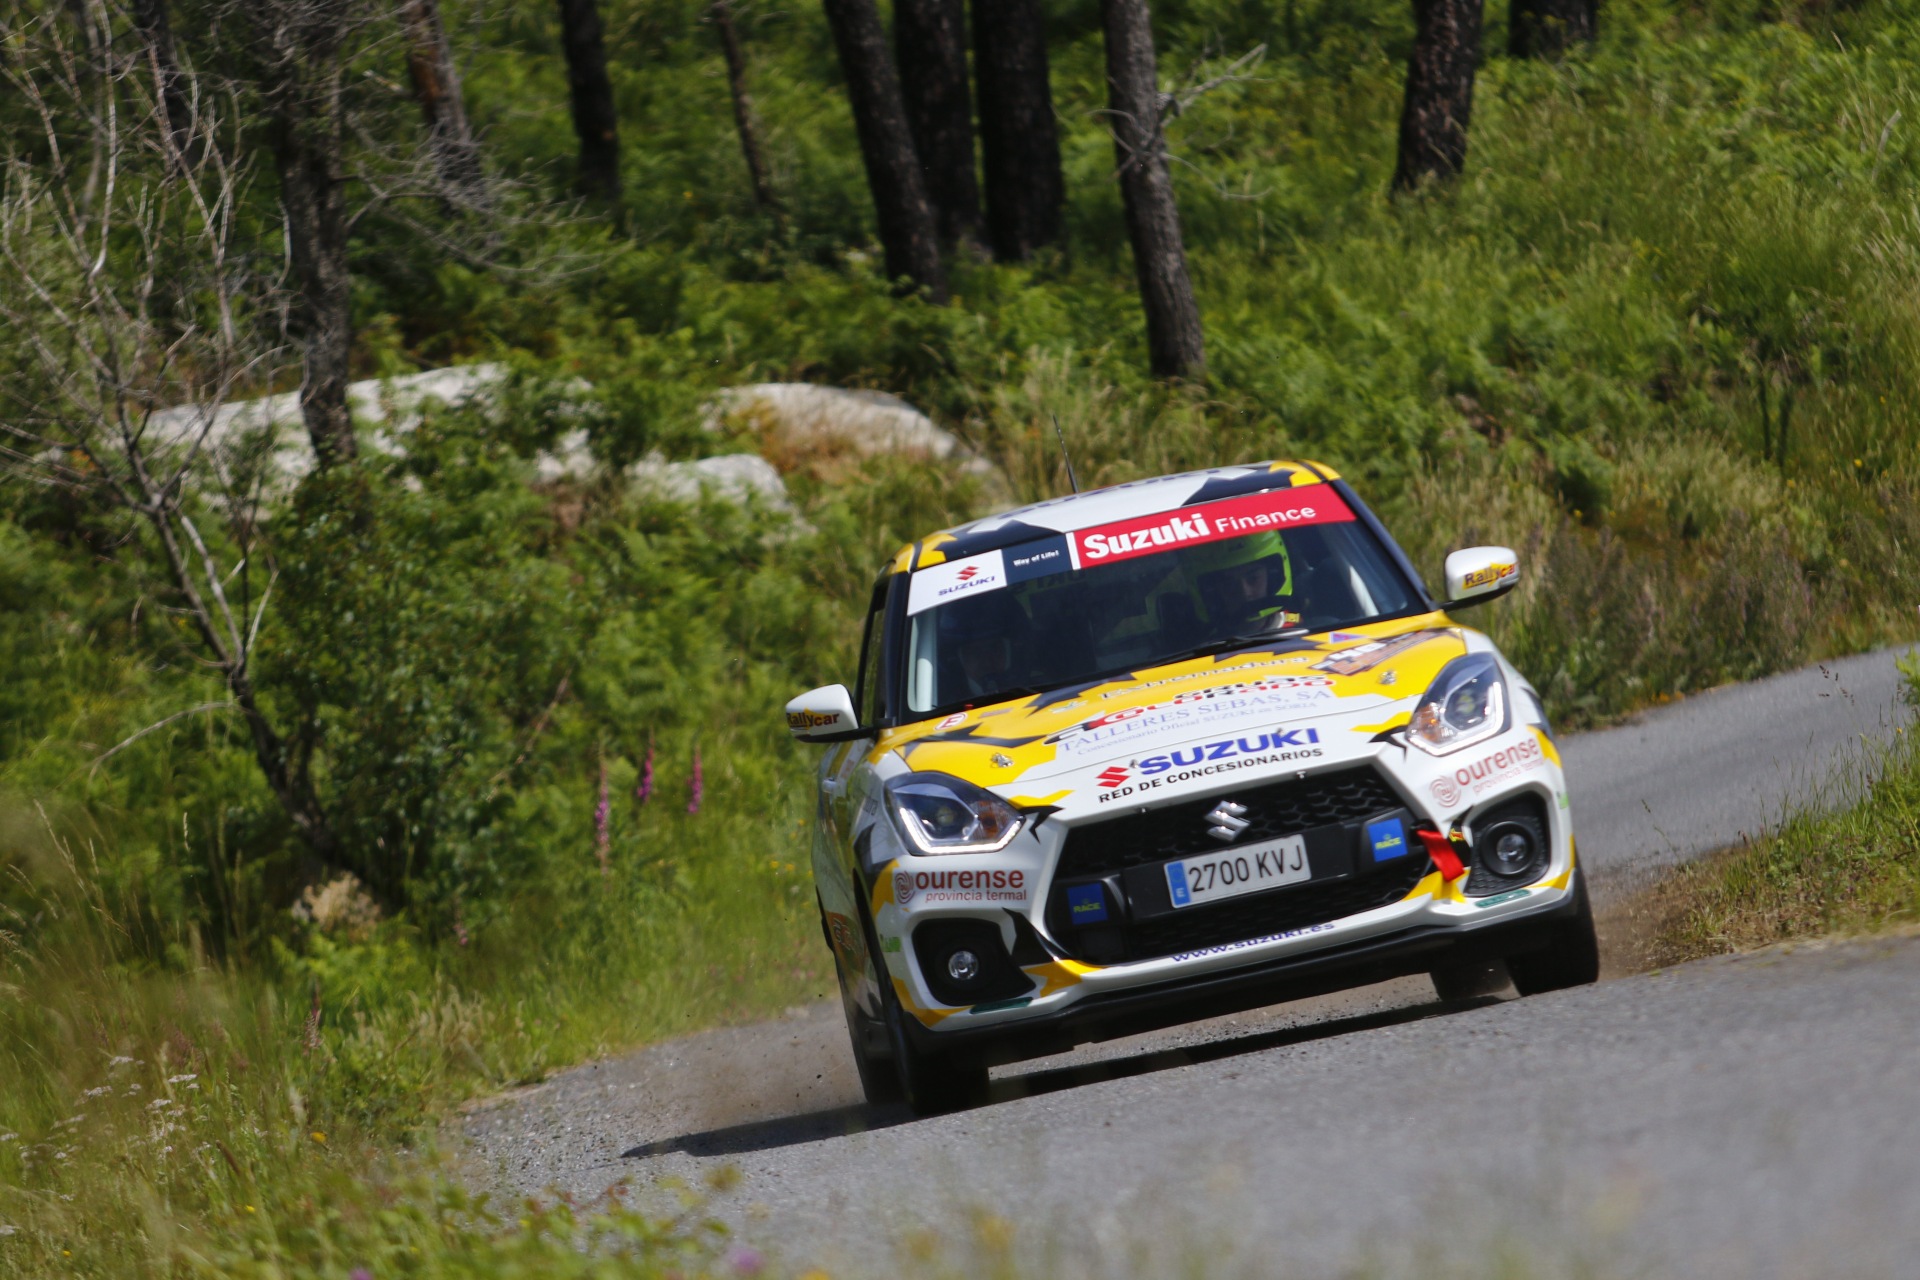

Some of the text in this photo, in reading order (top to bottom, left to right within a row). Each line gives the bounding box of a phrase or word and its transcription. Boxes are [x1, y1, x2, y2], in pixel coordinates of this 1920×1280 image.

[1083, 507, 1316, 559] Suzuki Finance
[1013, 549, 1060, 567] Way of Life!
[938, 576, 995, 597] SUZUKI
[1101, 656, 1309, 699] Extremadura
[1060, 708, 1190, 751] TALLERES
[1296, 690, 1331, 700] SA
[1203, 708, 1255, 723] SUZUKI
[1139, 727, 1320, 775] SUZUKI
[1455, 738, 1538, 786] ourense
[1098, 748, 1323, 804] RED DE CONCESIONARIOS
[915, 870, 1025, 890] ourense
[1176, 845, 1304, 898] E 2700 KVJ
[925, 889, 1027, 903] provincia termal
[1073, 902, 1101, 914] RACE
[1172, 922, 1335, 962] www.suzuki.es
